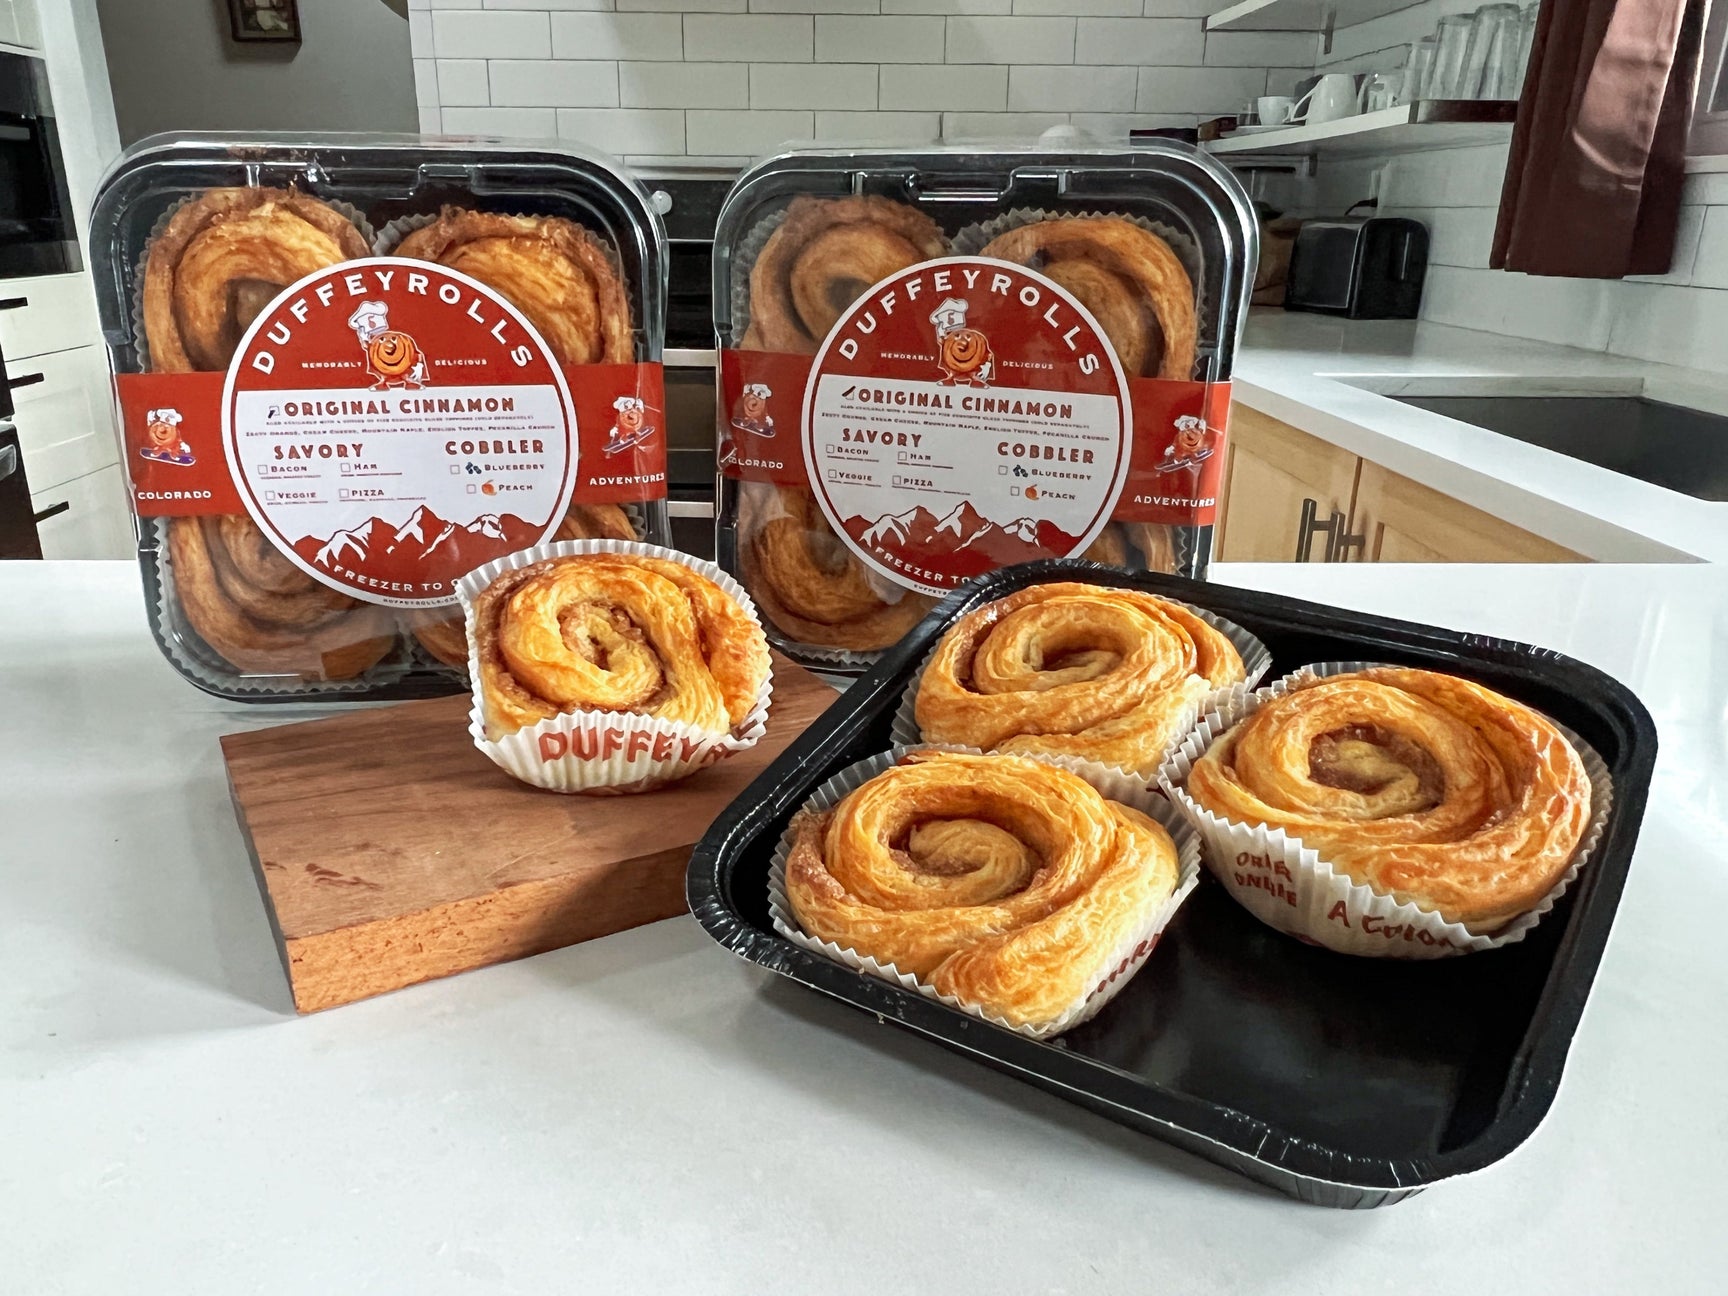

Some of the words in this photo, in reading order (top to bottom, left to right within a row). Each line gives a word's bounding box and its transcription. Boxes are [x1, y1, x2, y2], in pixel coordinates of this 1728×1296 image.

[252, 271, 533, 374] DUFFEYROLLS
[838, 269, 1100, 375] DUFFEYROLLS
[880, 352, 935, 361] MEMORABLY
[1002, 361, 1054, 369] DELICIOUS
[284, 400, 391, 417] ORIGINAL
[399, 397, 514, 414] CINNAMON
[858, 388, 953, 409] ORIGINAL
[961, 395, 1073, 419] CINNAMON
[842, 427, 922, 448] SAVORY
[274, 442, 364, 460] SAVORY
[445, 439, 544, 456] COBBLER
[997, 441, 1094, 464] COBBLER
[271, 465, 308, 473] BACON
[1031, 468, 1092, 480] BLUEBERRY
[589, 472, 665, 486] ADVENTURES
[903, 477, 934, 487] PIZZA
[137, 490, 212, 500] COLORADO
[277, 491, 317, 499] VEGGIE
[351, 489, 385, 497] PIZZA
[1133, 494, 1216, 508] ADVENTURES
[875, 546, 944, 582] FREEZER
[333, 564, 414, 593] FREEZER
[421, 583, 443, 591] TO
[1327, 900, 1351, 929] A
